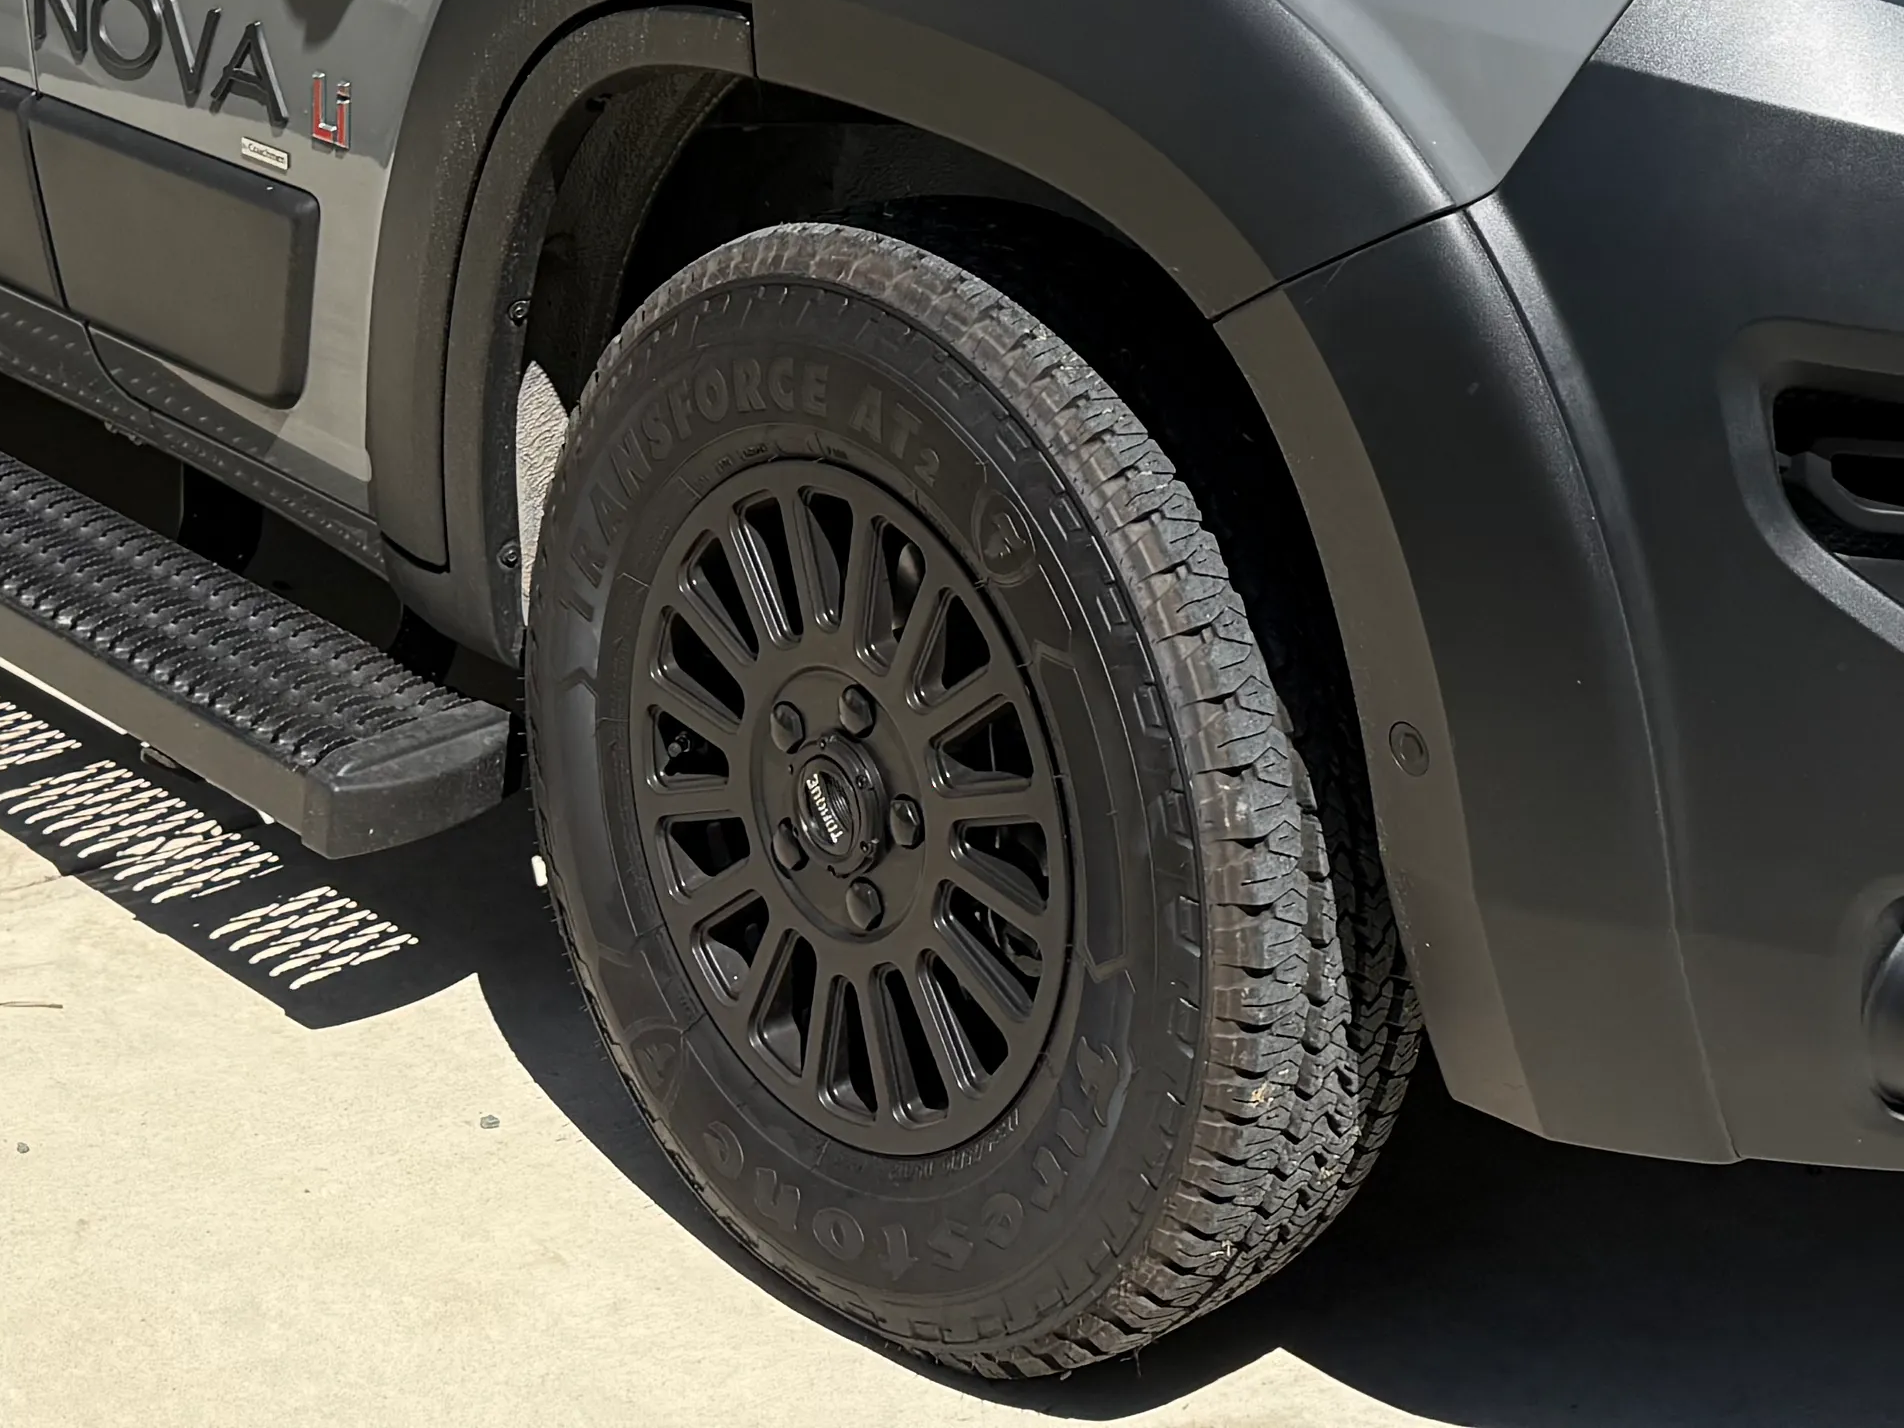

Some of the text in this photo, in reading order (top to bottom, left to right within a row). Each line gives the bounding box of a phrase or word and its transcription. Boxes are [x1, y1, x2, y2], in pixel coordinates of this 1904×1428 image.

[560, 357, 830, 622] TRANSFORCE
[806, 773, 844, 844] TORQUE
[702, 1036, 1120, 1281] Firestone
